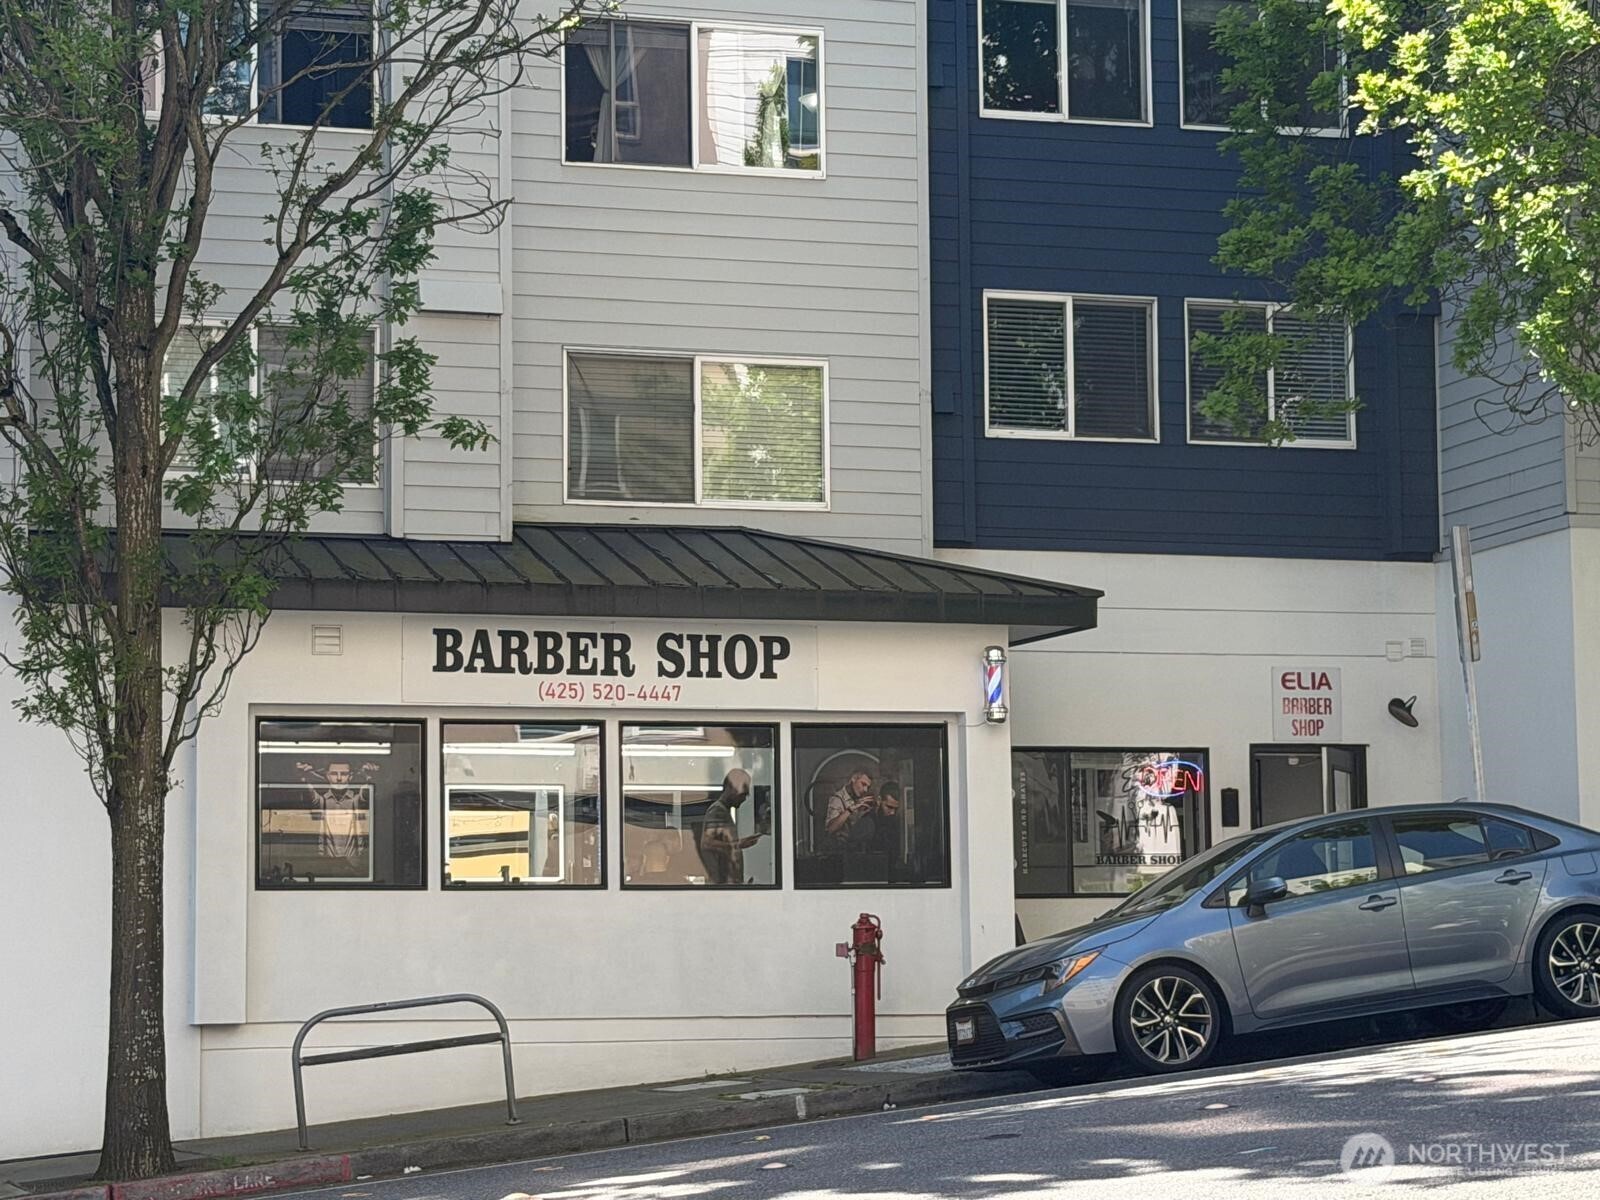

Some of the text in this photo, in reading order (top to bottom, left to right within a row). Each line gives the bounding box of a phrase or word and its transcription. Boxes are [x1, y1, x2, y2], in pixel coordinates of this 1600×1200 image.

[432, 628, 791, 680] BARBER SHOP
[1281, 671, 1333, 690] ELIA
[537, 681, 682, 703] (425) 520-4447
[1282, 697, 1333, 715] BARBER
[1291, 718, 1324, 736] SHOP
[1139, 766, 1201, 792] OPEN
[1096, 854, 1147, 865] BARBER
